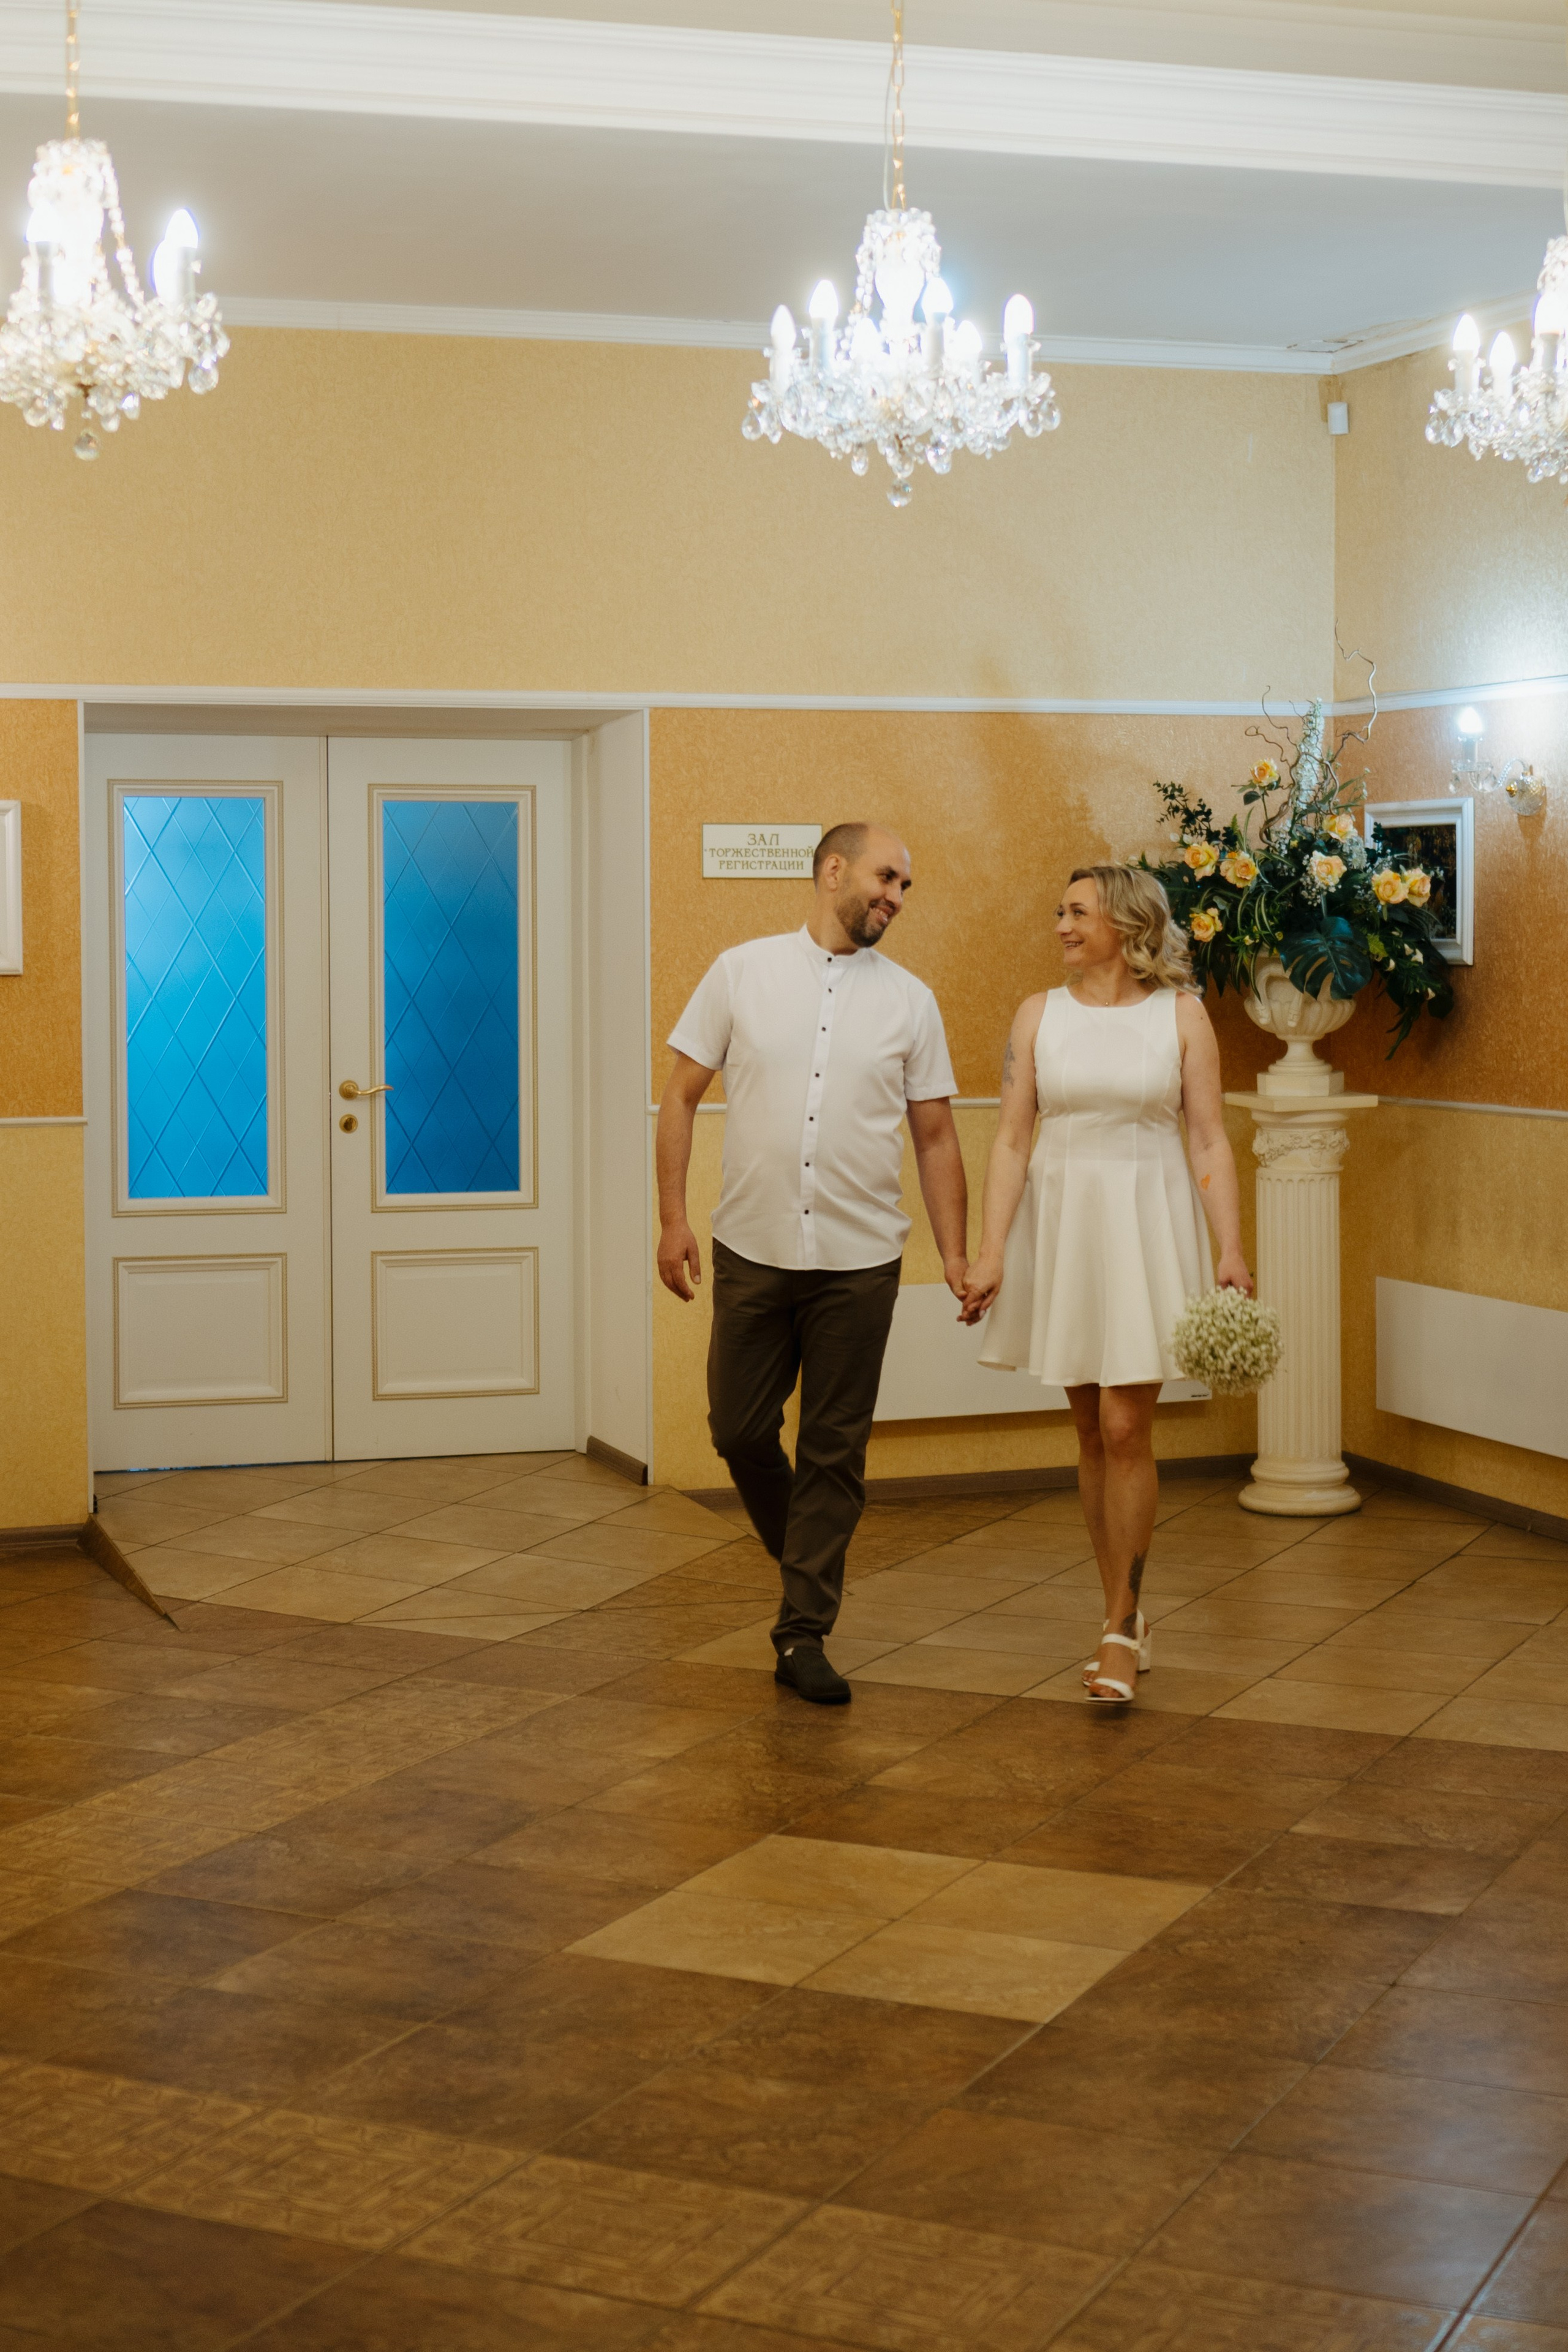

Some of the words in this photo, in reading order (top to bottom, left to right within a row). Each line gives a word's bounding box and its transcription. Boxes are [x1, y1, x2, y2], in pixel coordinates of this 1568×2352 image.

[747, 833, 780, 846] ЗАЛ
[709, 845, 814, 858] ТОРЖЕСТВЕННОЙ
[718, 860, 804, 872] РЕГИСТРАЦИИ
